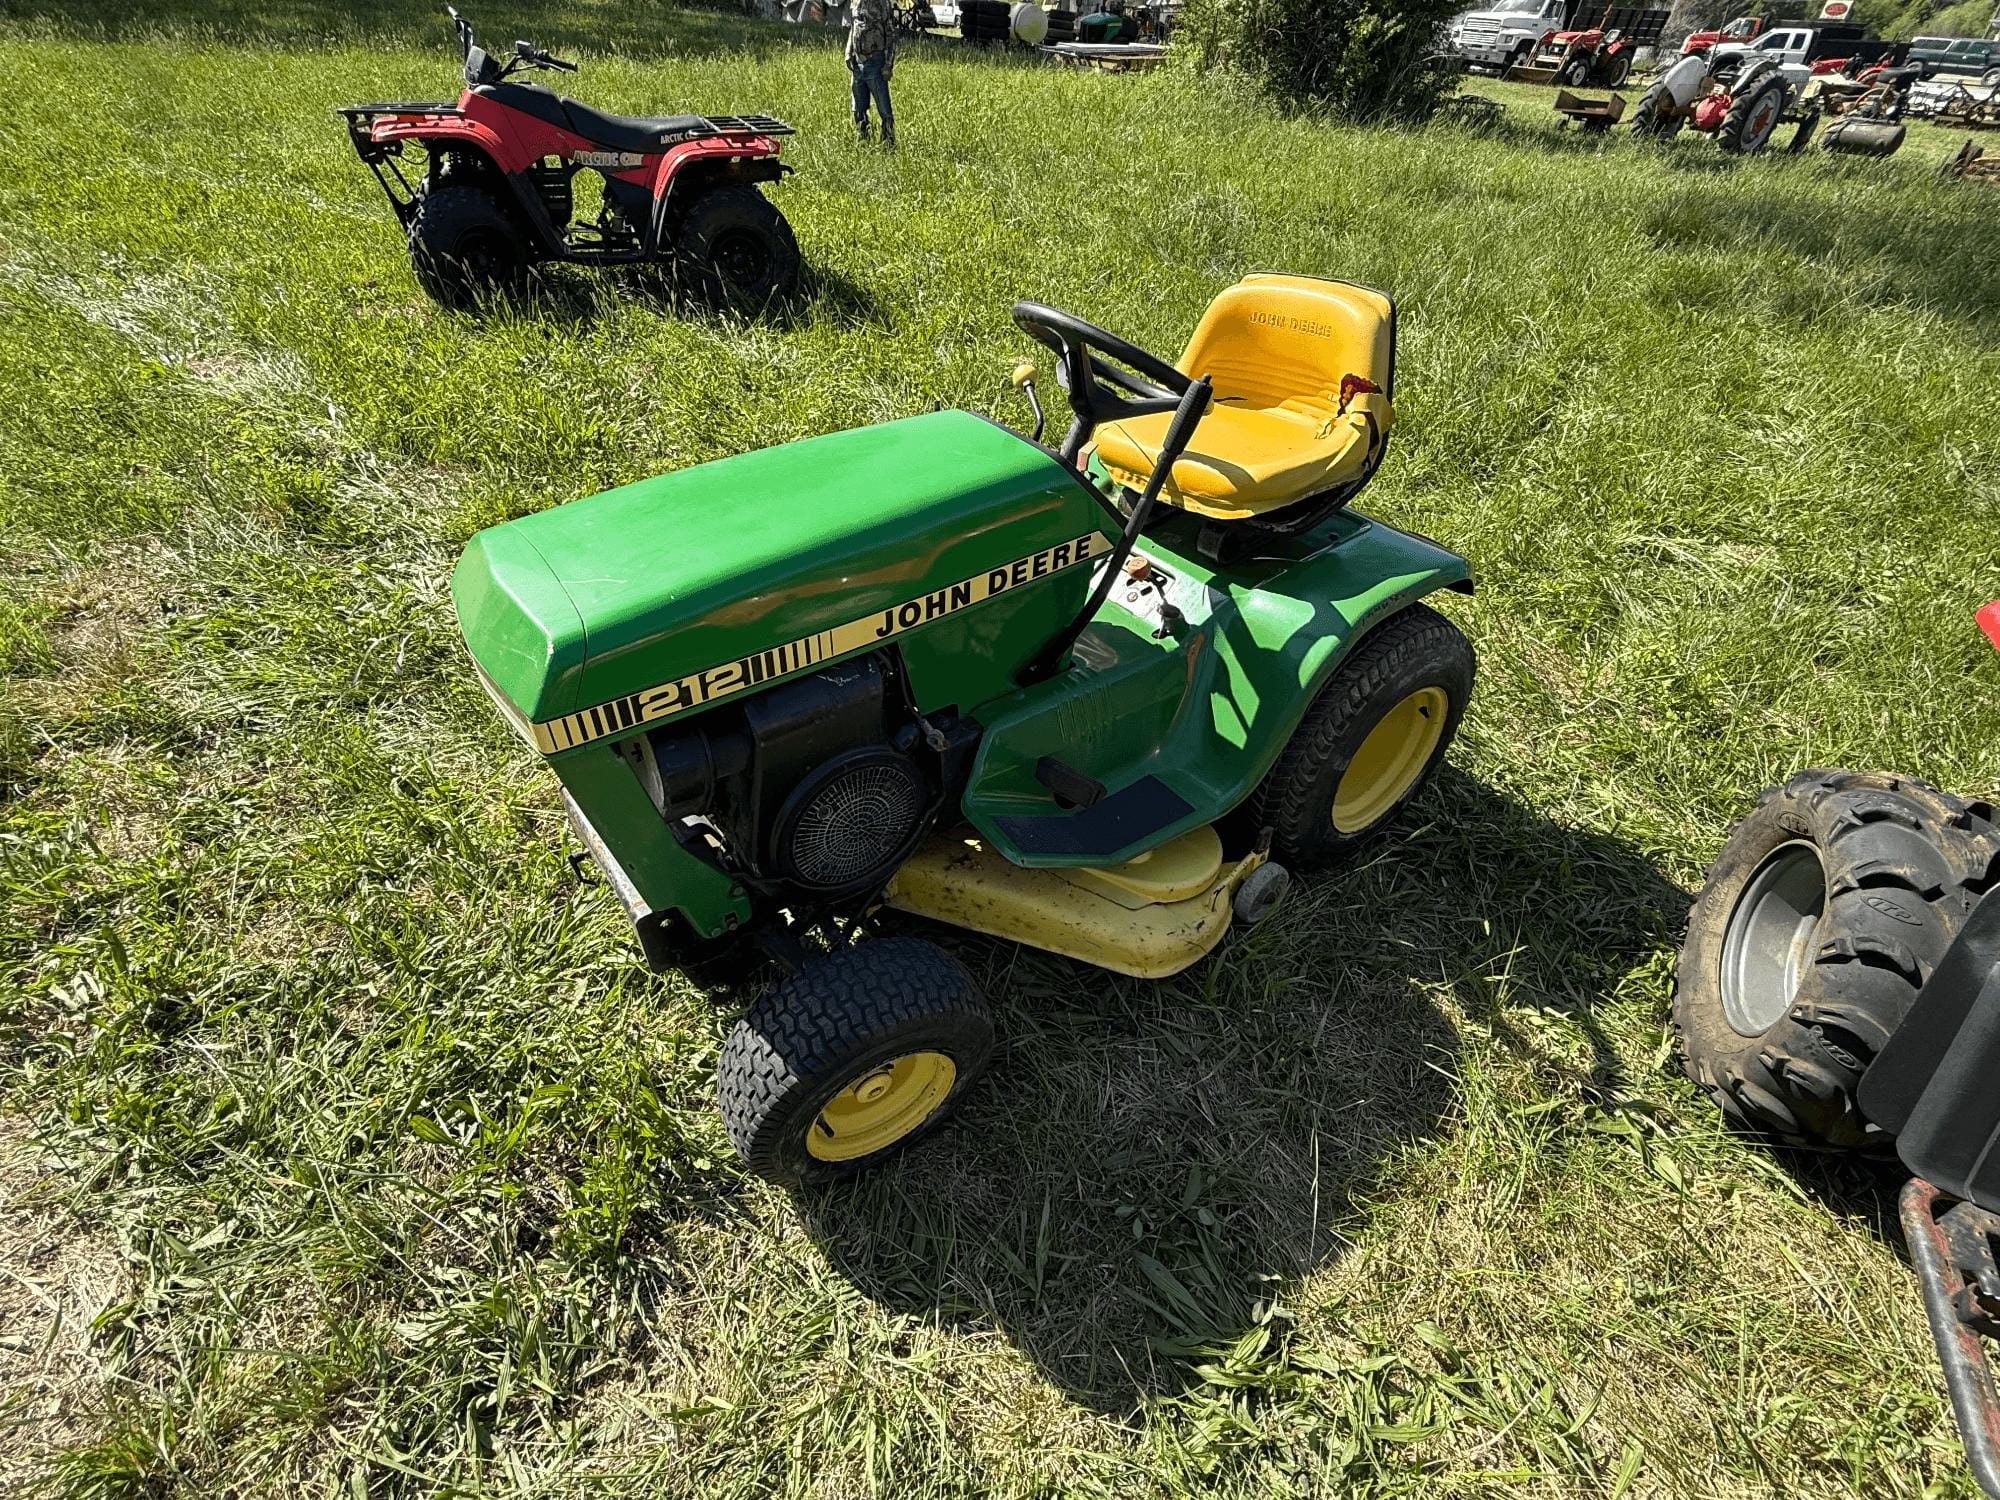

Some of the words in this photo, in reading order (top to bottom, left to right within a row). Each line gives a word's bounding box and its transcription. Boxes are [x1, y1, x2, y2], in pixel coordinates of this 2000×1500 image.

[661, 132, 684, 144] ARCTIC
[574, 150, 619, 166] ARCTIC
[1249, 312, 1285, 328] JOHN
[1290, 317, 1332, 339] DEERE
[876, 581, 971, 638] JOHN
[988, 536, 1092, 595] DEERE
[638, 662, 745, 721] 212
